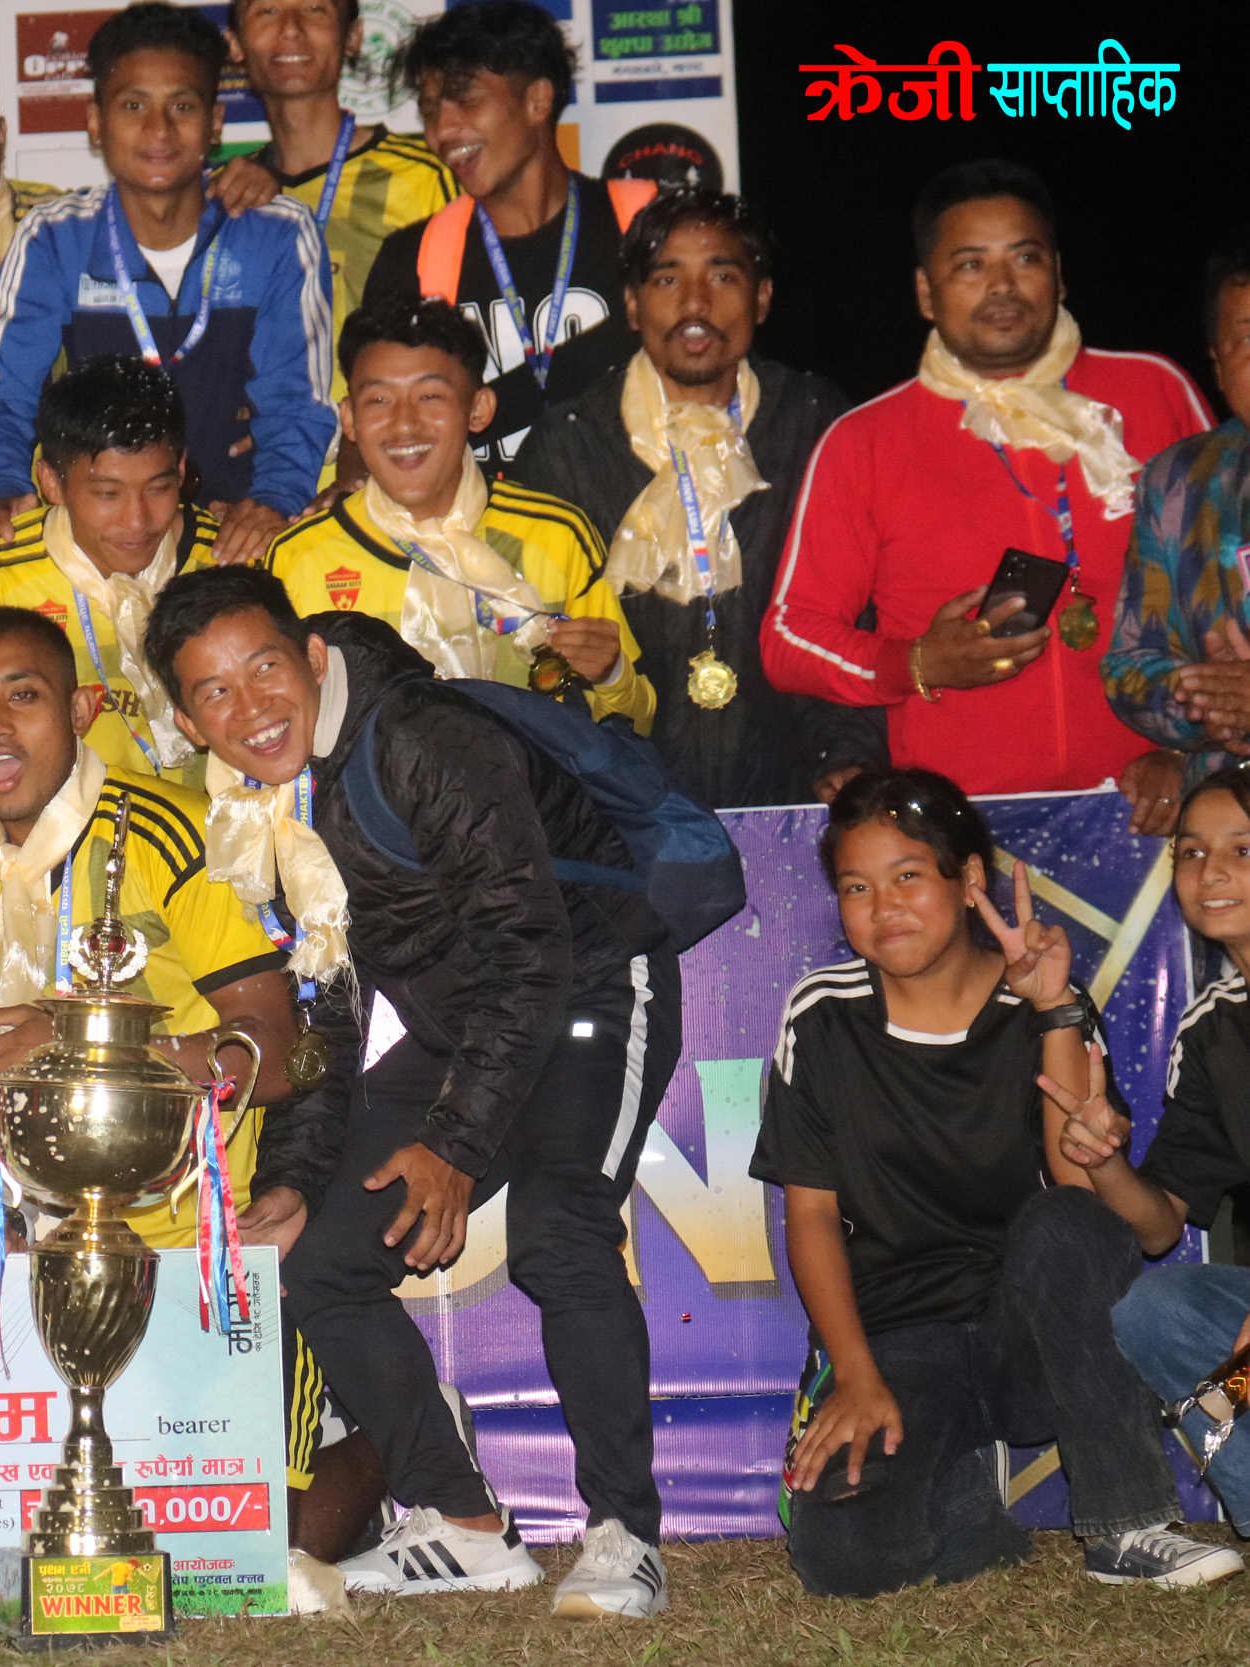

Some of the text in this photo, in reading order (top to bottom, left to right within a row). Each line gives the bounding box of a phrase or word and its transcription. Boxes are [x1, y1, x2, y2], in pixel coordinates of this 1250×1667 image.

[157, 1416, 231, 1435] bearer
[201, 1456, 246, 1478] मात्र
[38, 1561, 91, 1577] प्रथम एनी
[45, 1583, 86, 1595] २०७८
[39, 1593, 144, 1618] WINNER
